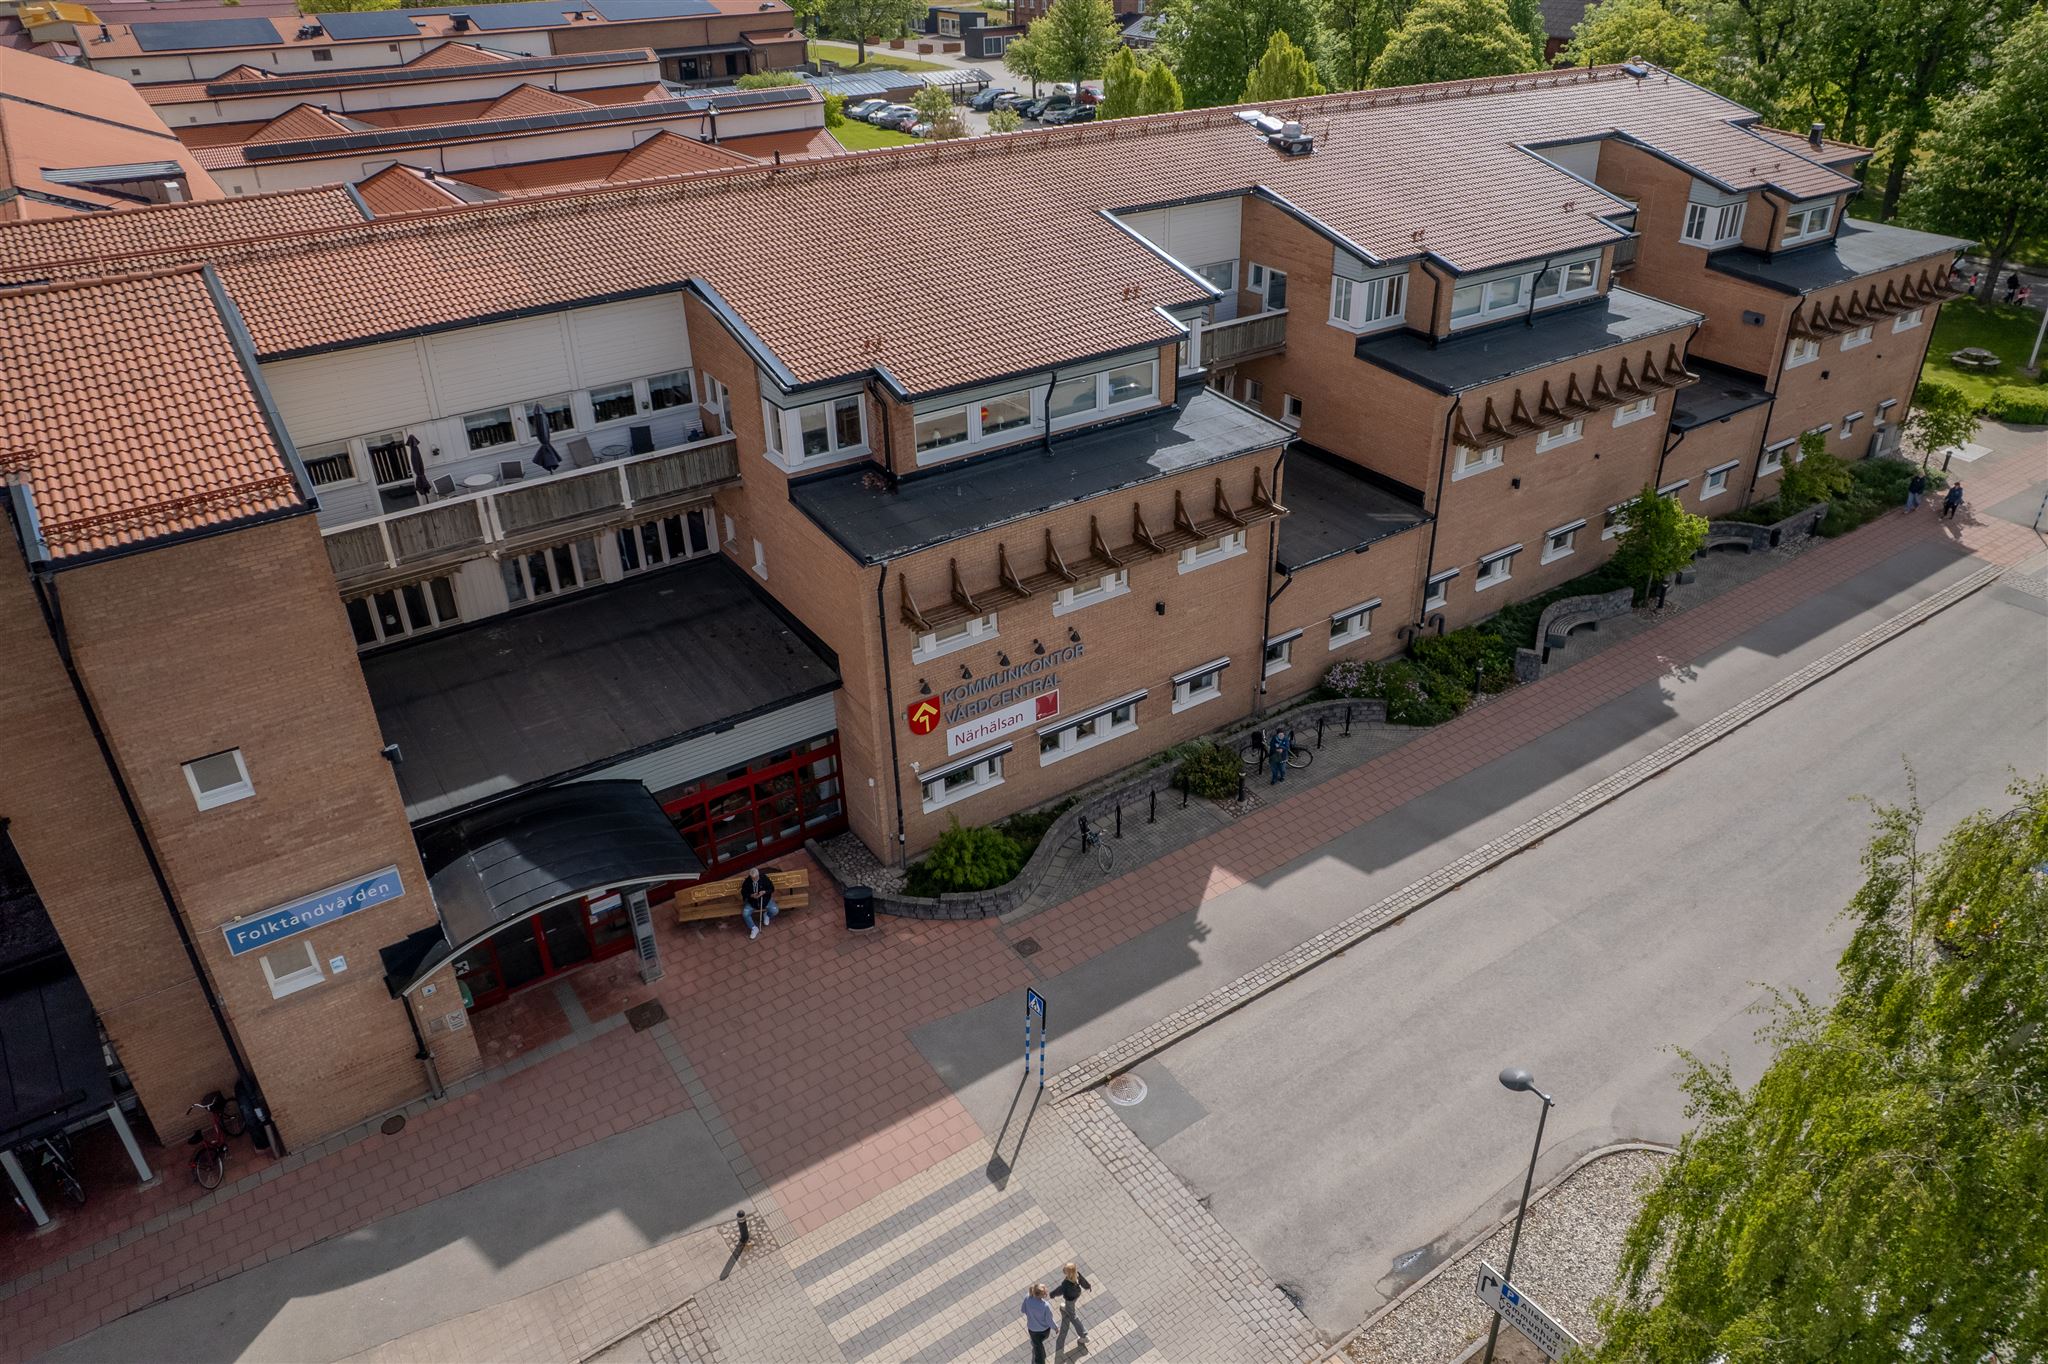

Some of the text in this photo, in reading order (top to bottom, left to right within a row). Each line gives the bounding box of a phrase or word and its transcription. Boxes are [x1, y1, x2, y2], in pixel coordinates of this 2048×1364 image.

[942, 643, 1085, 706] KOMMUNKONTOR
[943, 672, 1063, 724] VÅRDCENTRAL
[954, 711, 1025, 747] Närhälsan
[236, 882, 390, 945] Folktandvården
[1520, 1303, 1571, 1346] Allétorg
